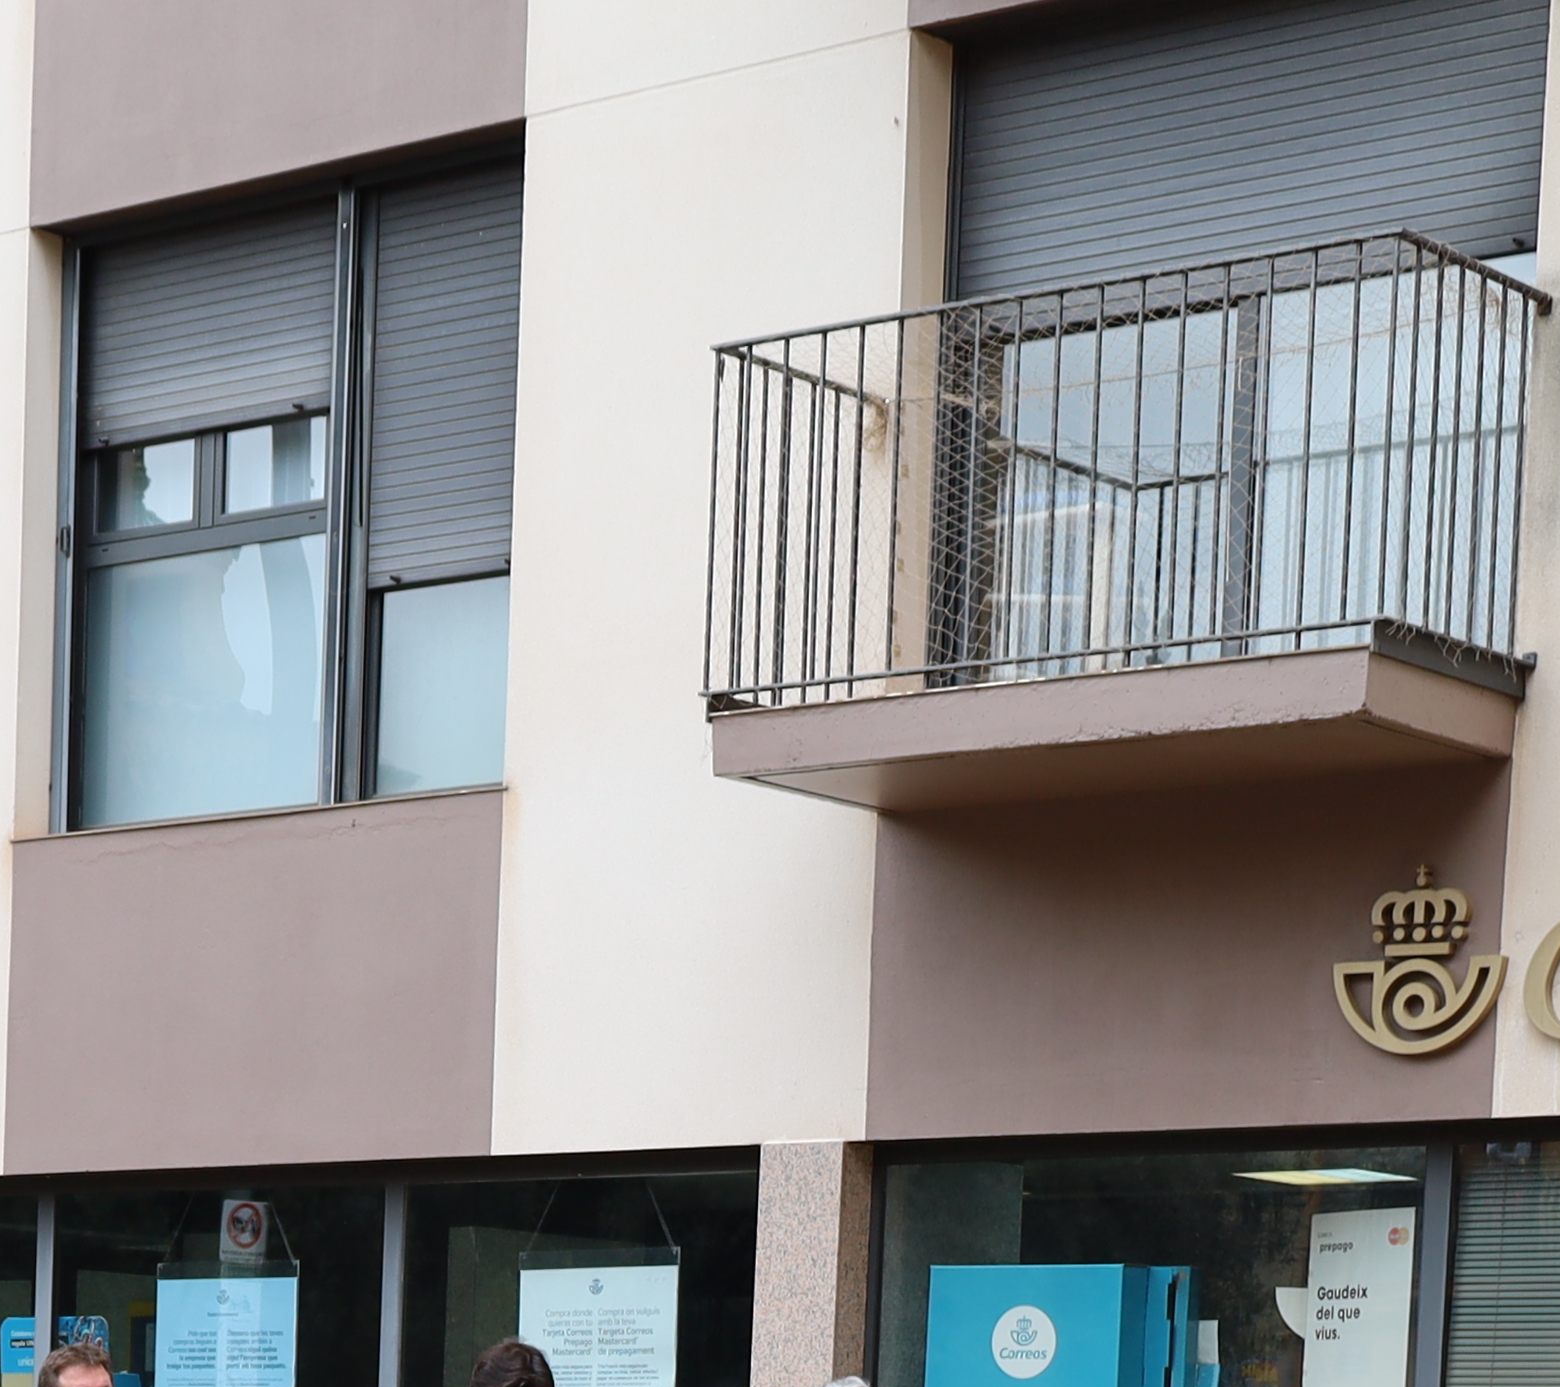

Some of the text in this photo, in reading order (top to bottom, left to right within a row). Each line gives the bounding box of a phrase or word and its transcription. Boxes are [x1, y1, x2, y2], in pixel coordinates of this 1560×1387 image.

[1319, 1240, 1354, 1254] prepago
[1316, 1284, 1369, 1301] Gaudeix
[545, 1308, 593, 1318] Compra donde
[597, 1307, 624, 1317] Compra
[1315, 1305, 1361, 1322] del que
[566, 1328, 593, 1337] Correos
[626, 1326, 654, 1336] Correos
[1315, 1325, 1341, 1341] vius.
[563, 1338, 593, 1348] Prepago
[998, 1347, 1048, 1360] Correos
